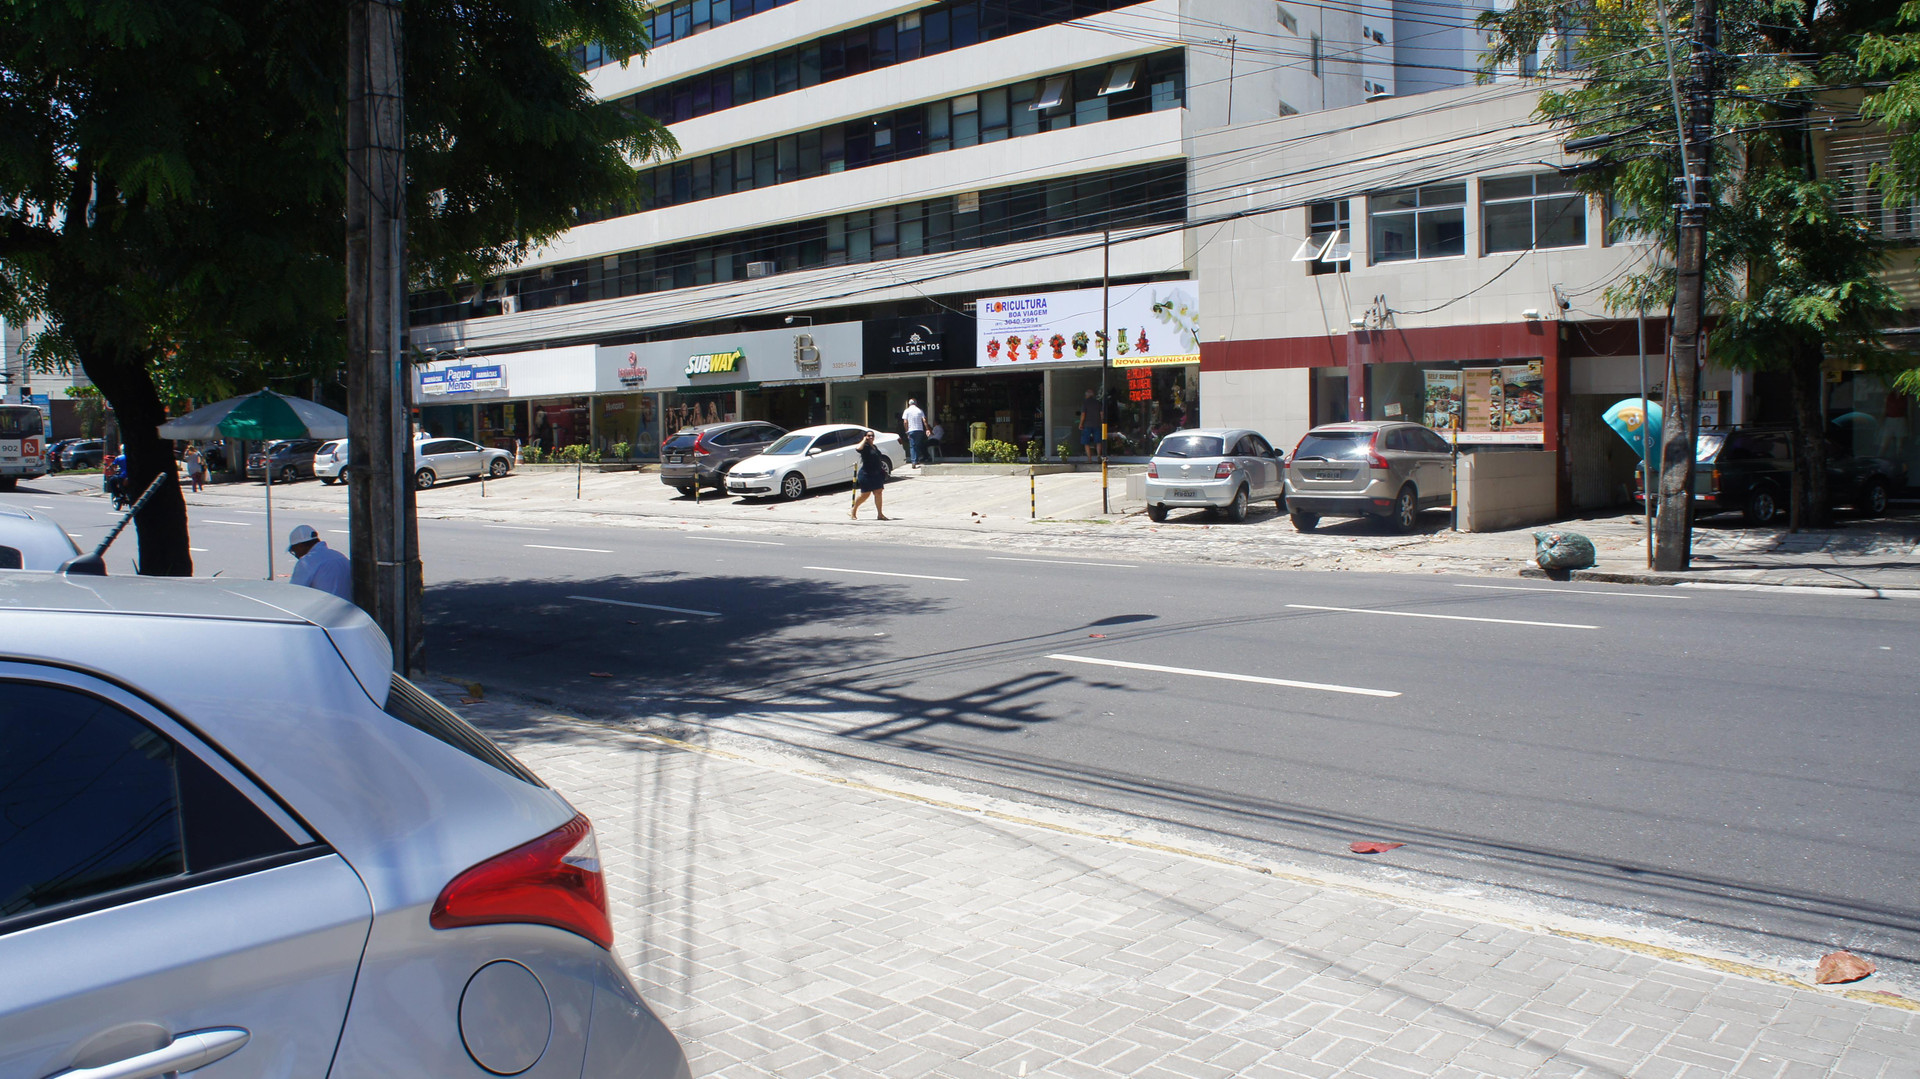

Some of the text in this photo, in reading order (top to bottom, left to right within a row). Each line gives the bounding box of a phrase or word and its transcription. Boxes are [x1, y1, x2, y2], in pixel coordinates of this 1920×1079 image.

[985, 298, 1047, 313] FLORICULTURA
[1022, 309, 1048, 317] VIAGEM
[685, 351, 740, 374] SUBWAY
[447, 369, 471, 381] Pague
[447, 380, 472, 391] Menos
